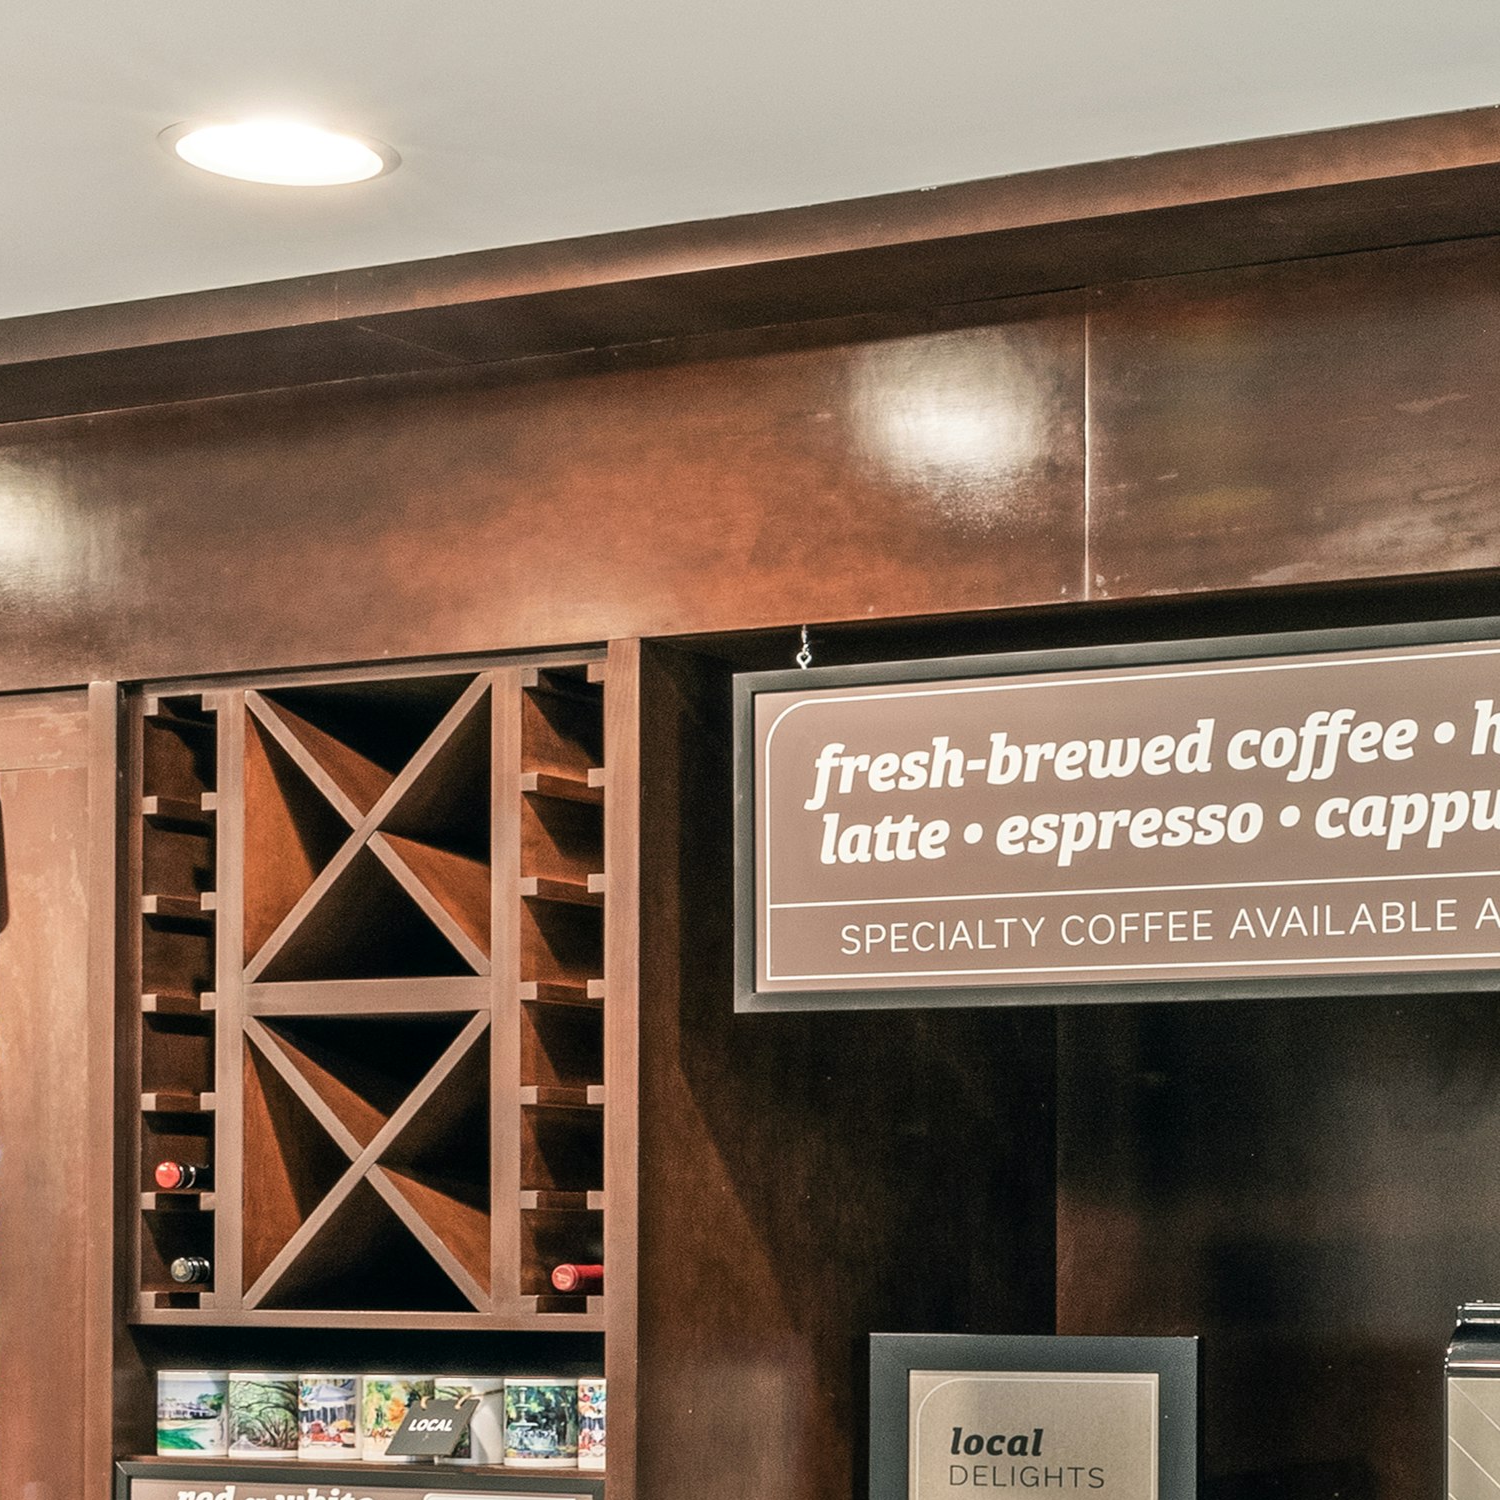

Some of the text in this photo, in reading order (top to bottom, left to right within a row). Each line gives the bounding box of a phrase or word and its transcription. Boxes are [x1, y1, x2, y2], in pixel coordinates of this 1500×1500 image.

[805, 717, 1214, 811] fresh-brewed
[1226, 709, 1414, 786] coffee
[819, 812, 947, 865] latte
[994, 797, 1264, 867] espresso
[840, 917, 1045, 956] SPECIALTY
[1060, 908, 1213, 947] COFFEE
[1229, 899, 1459, 941] AVAILABLE
[407, 1418, 453, 1432] LOCAL
[950, 1427, 1044, 1457] local
[949, 1464, 1106, 1489] DELIGHTS
